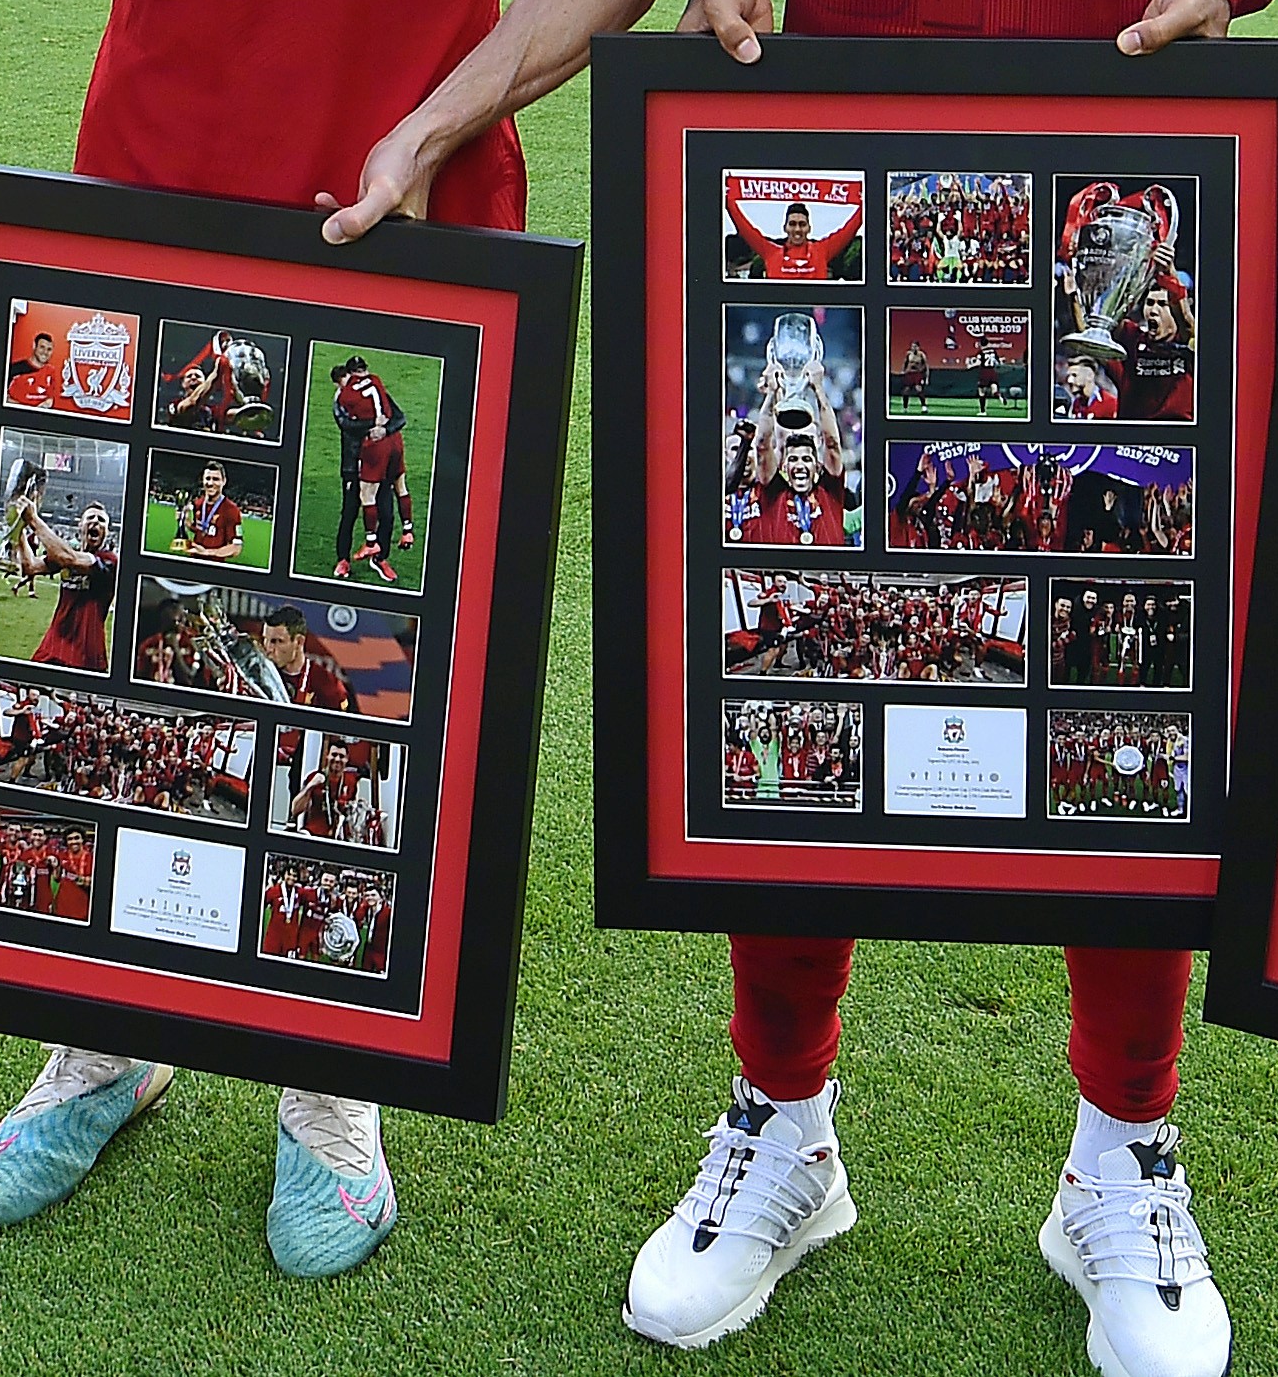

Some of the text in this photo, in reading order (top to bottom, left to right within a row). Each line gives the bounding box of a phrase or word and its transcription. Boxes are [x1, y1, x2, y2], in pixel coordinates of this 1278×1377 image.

[739, 179, 850, 196] LIVERPOOL FC
[958, 315, 981, 324] CLUB
[981, 316, 1012, 324] WORLD
[966, 324, 1022, 336] QATAR 2019
